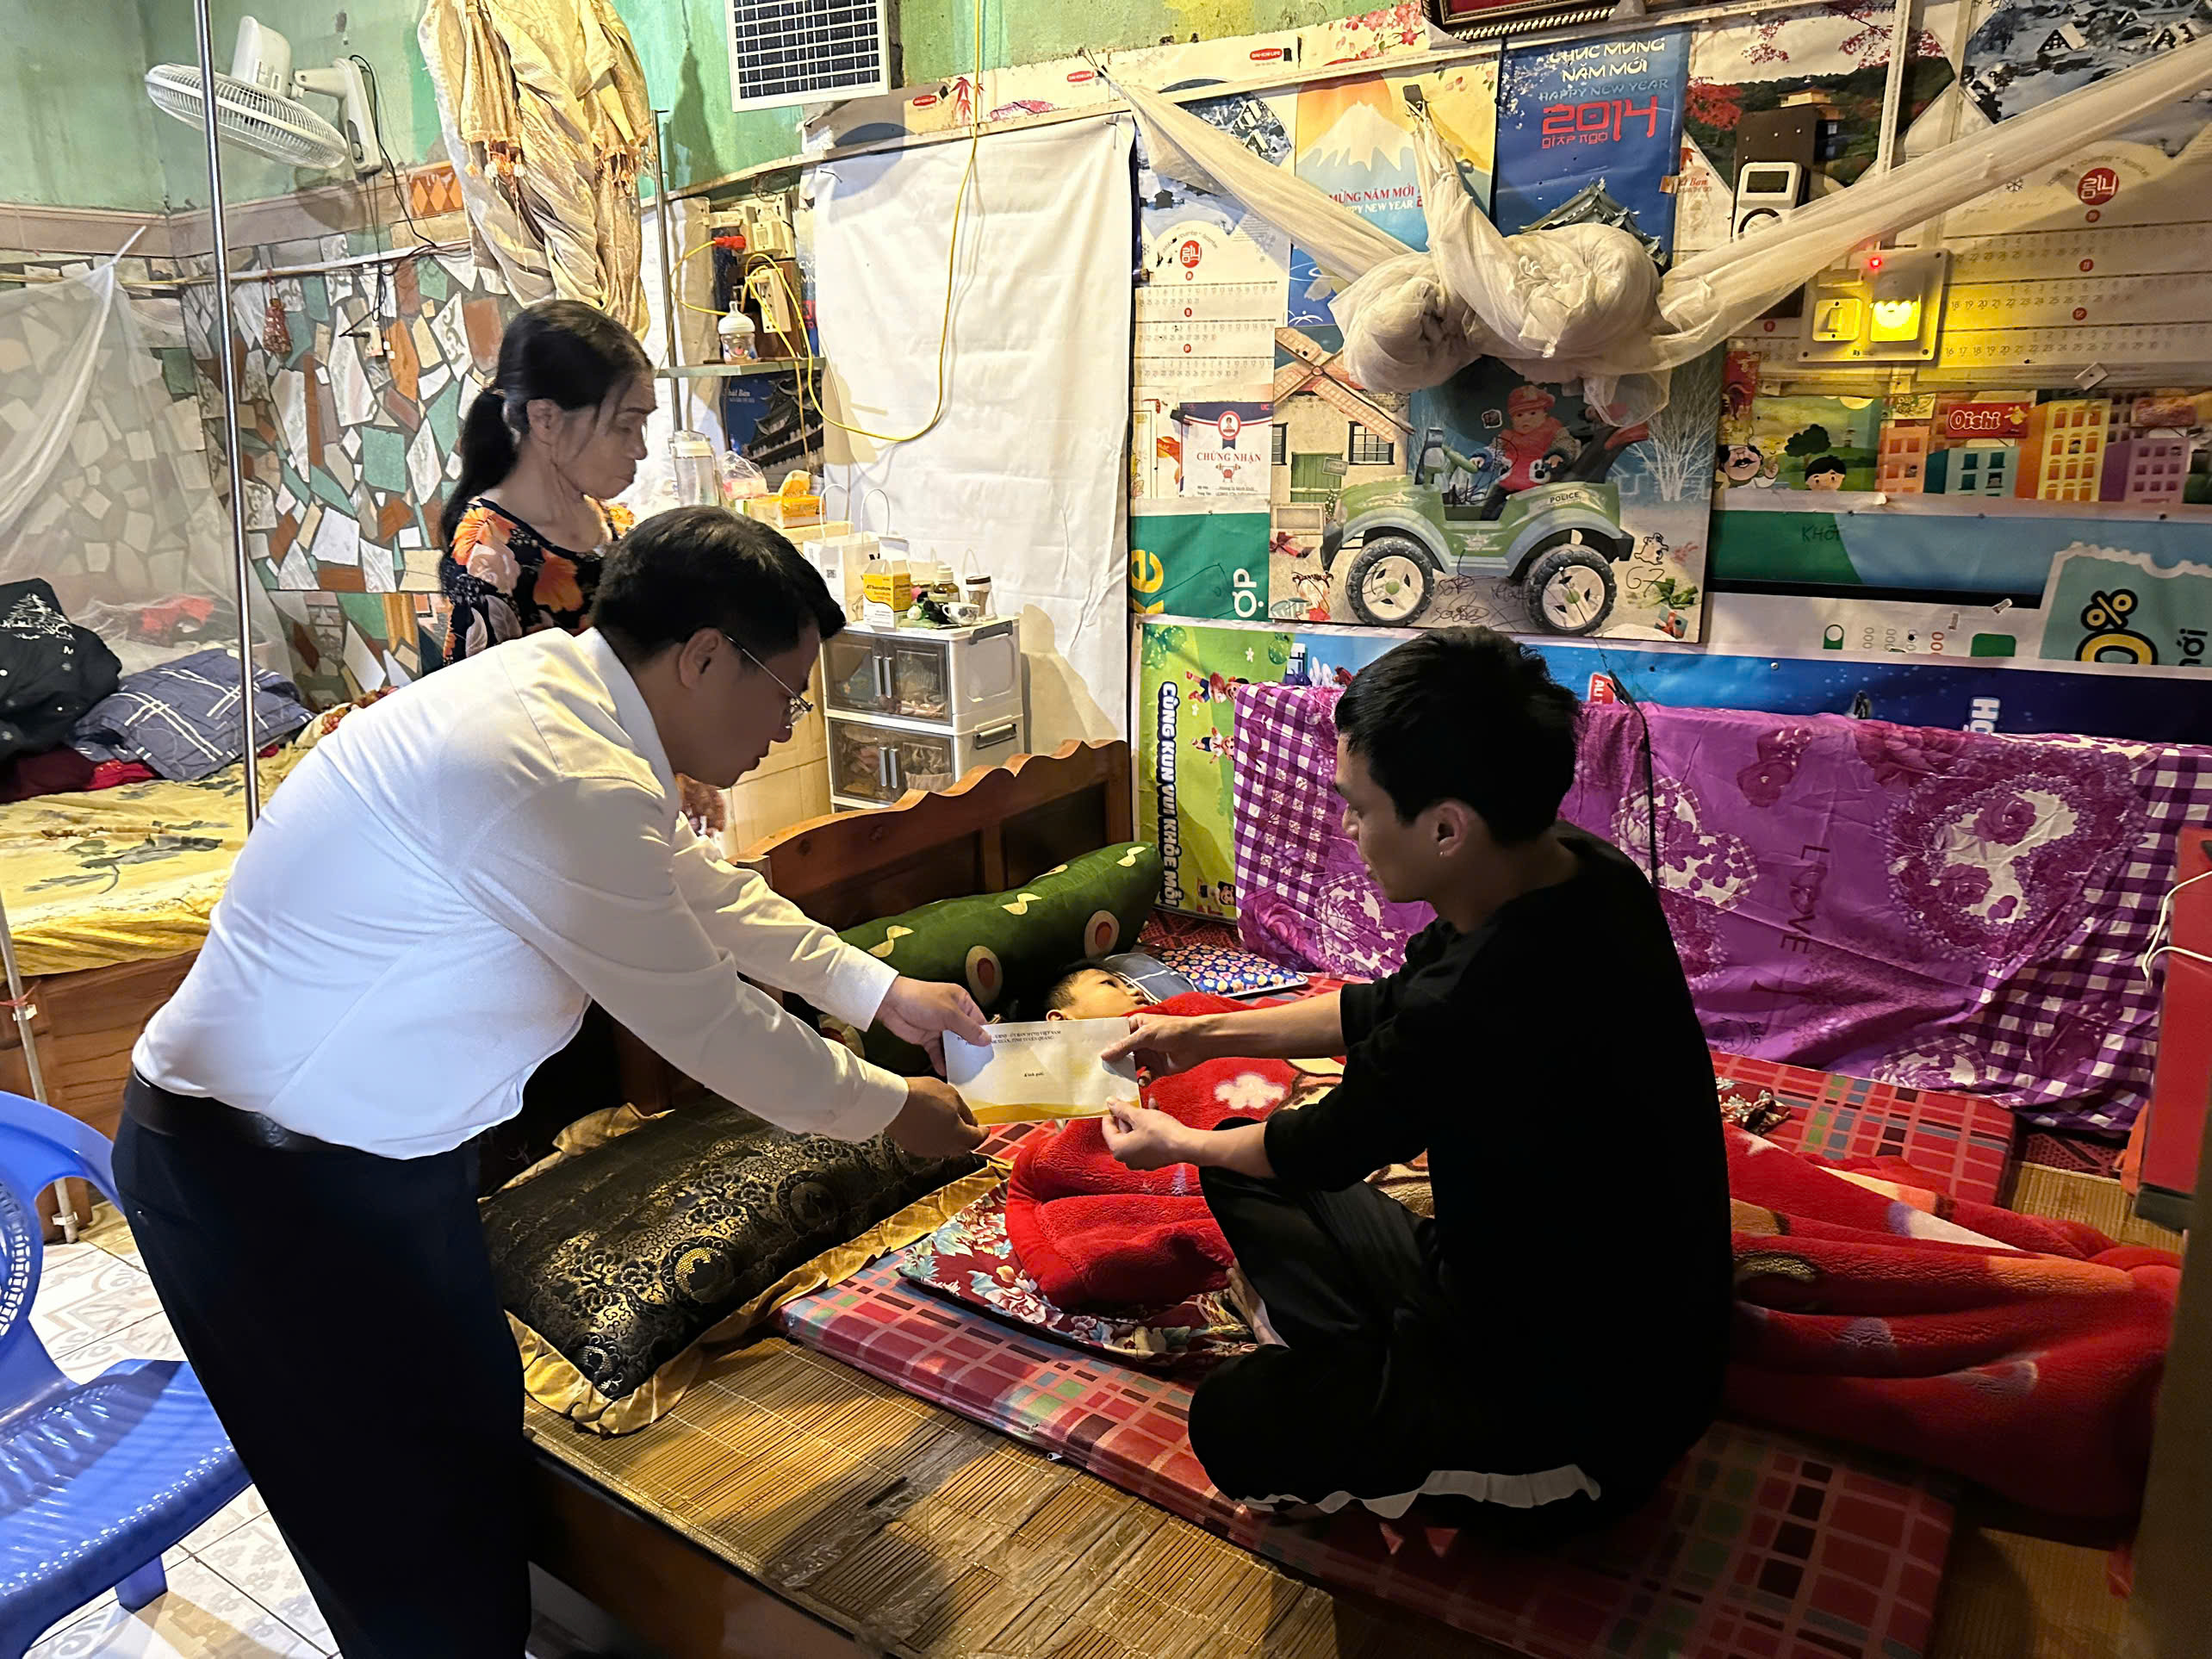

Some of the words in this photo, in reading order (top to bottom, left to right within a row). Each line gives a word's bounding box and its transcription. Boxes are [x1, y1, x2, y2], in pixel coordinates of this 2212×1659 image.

[1609, 57, 1648, 76] MỚI
[1538, 88, 1587, 101] HAPPY
[1590, 84, 1625, 96] NEW
[1630, 79, 1668, 90] YEAR
[1542, 96, 1657, 141] 2014
[1364, 188, 1389, 201] NĂM
[1393, 183, 1414, 197] MỚI
[1365, 202, 1387, 214] NEW
[1389, 199, 1414, 211] YEAR
[1949, 409, 2001, 430] Oishi
[1196, 450, 1231, 462] CHỨNG
[1233, 452, 1262, 464] NHẬN
[1550, 492, 1580, 503] POLICE
[1161, 681, 1179, 739] CÙNG
[1161, 740, 1176, 784] KUN
[1162, 784, 1177, 817] VUI
